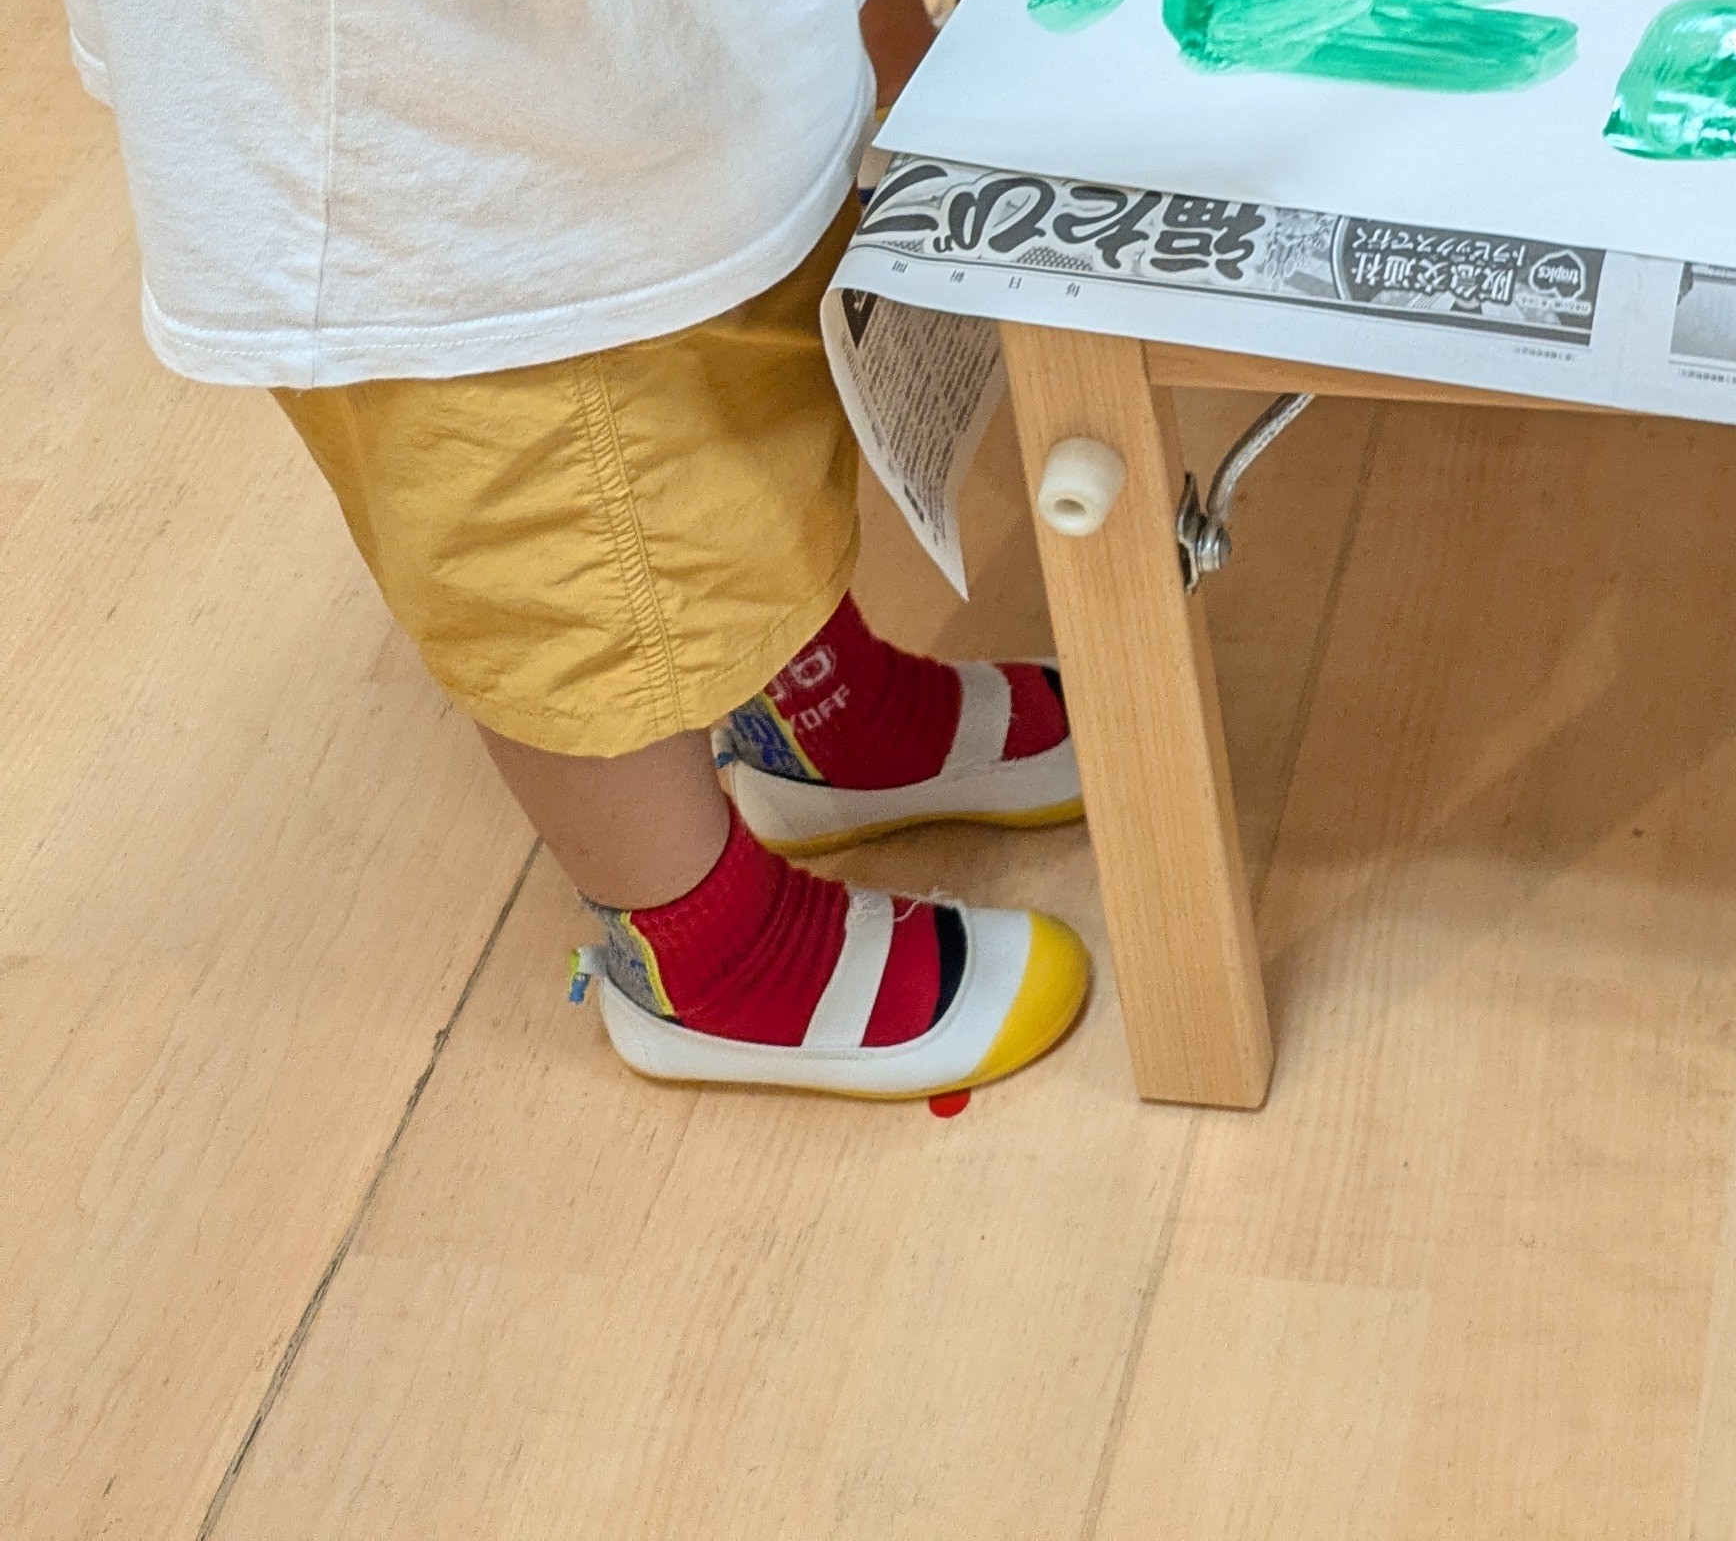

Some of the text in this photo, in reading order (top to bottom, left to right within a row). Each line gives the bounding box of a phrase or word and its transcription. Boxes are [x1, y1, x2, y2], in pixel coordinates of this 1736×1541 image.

[1351, 227, 1526, 267] トラピックスで行く
[1350, 250, 1514, 303] 阪急交通社
